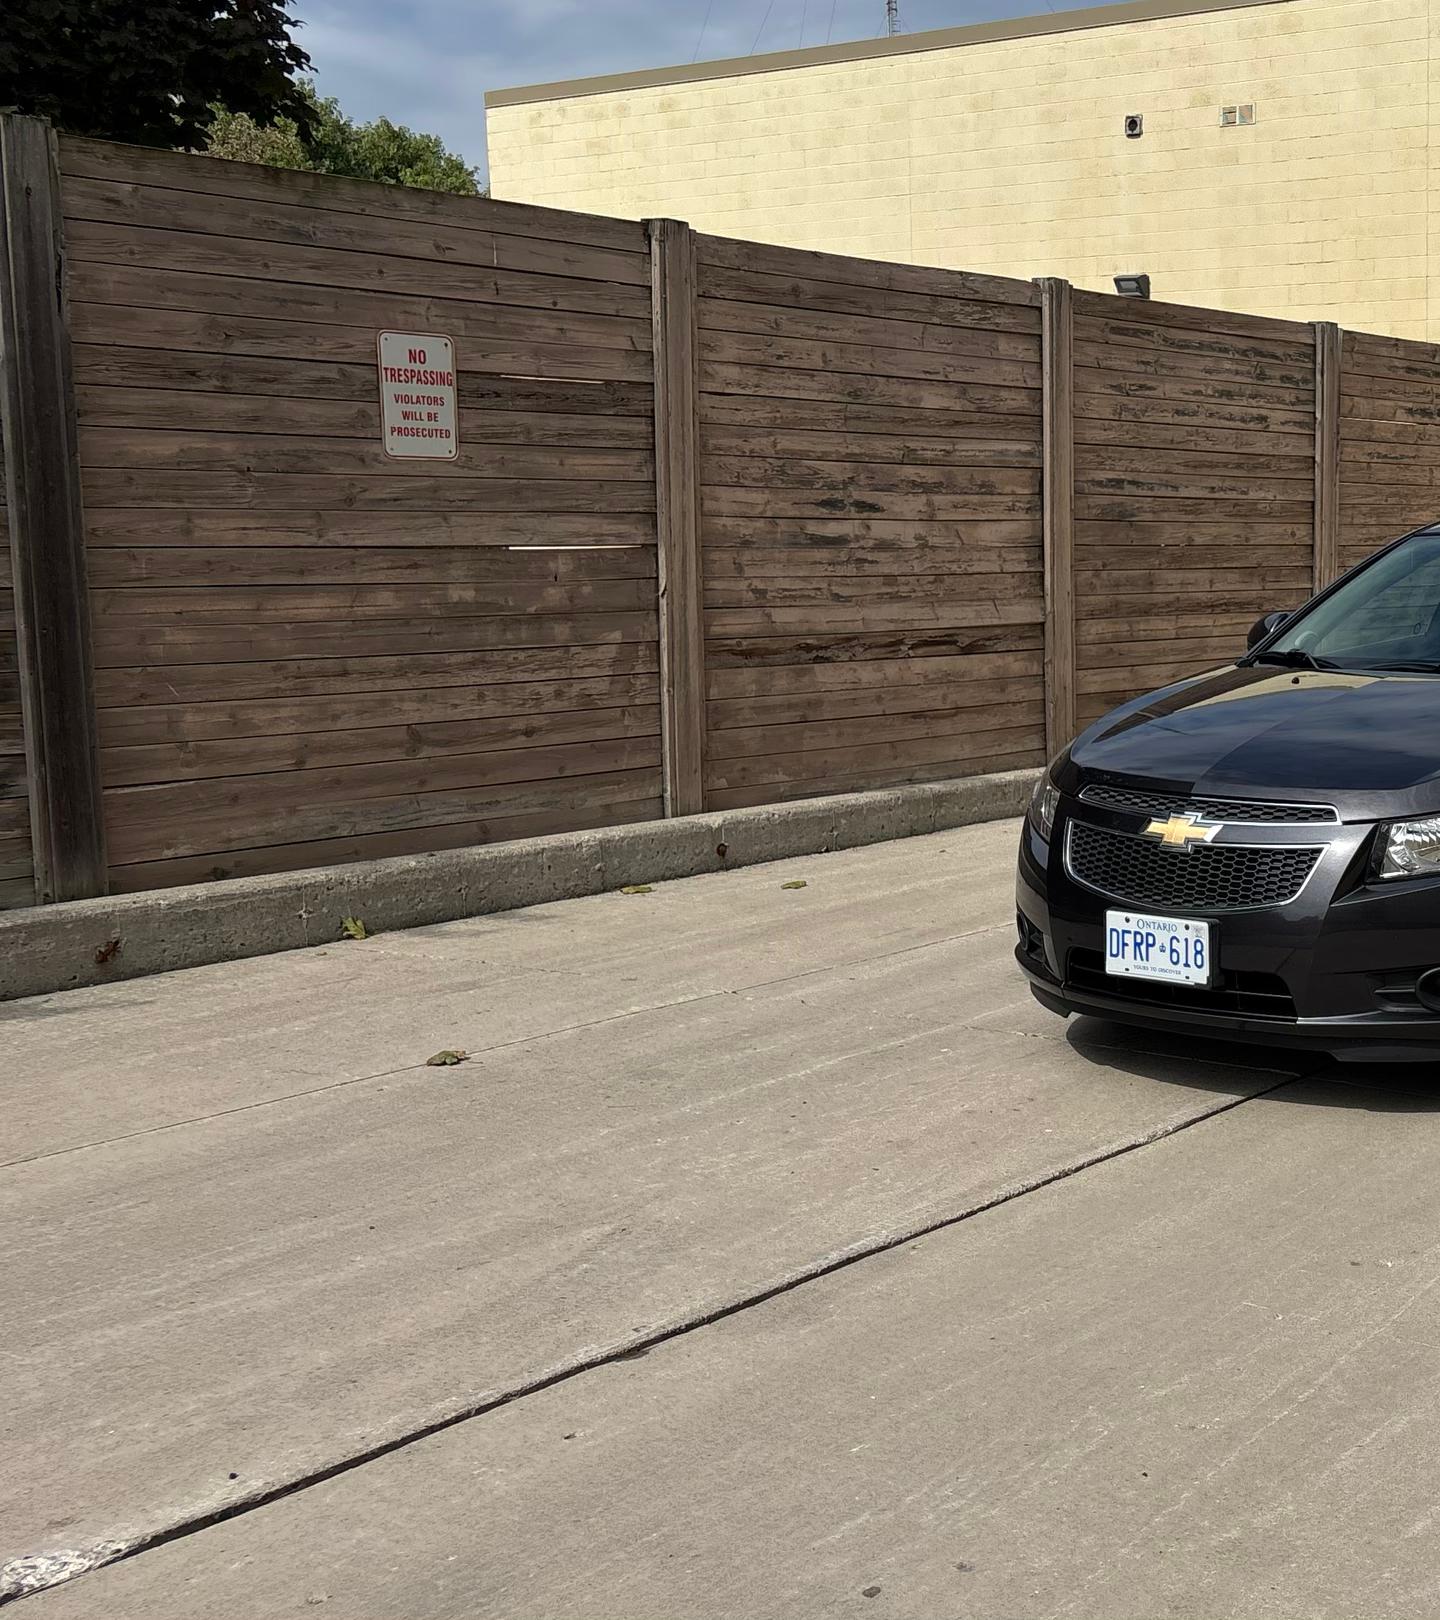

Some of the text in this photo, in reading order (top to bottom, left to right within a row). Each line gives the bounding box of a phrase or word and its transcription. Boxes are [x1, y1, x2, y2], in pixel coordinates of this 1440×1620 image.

[408, 349, 426, 364] NO
[383, 367, 453, 387] TRESPASSING
[394, 393, 445, 407] VIOLATORS
[402, 410, 439, 422] WILL BE
[390, 426, 451, 439] PROSECUTED
[1136, 918, 1178, 933] ONTARIO
[1109, 927, 1204, 969] DFRP 618
